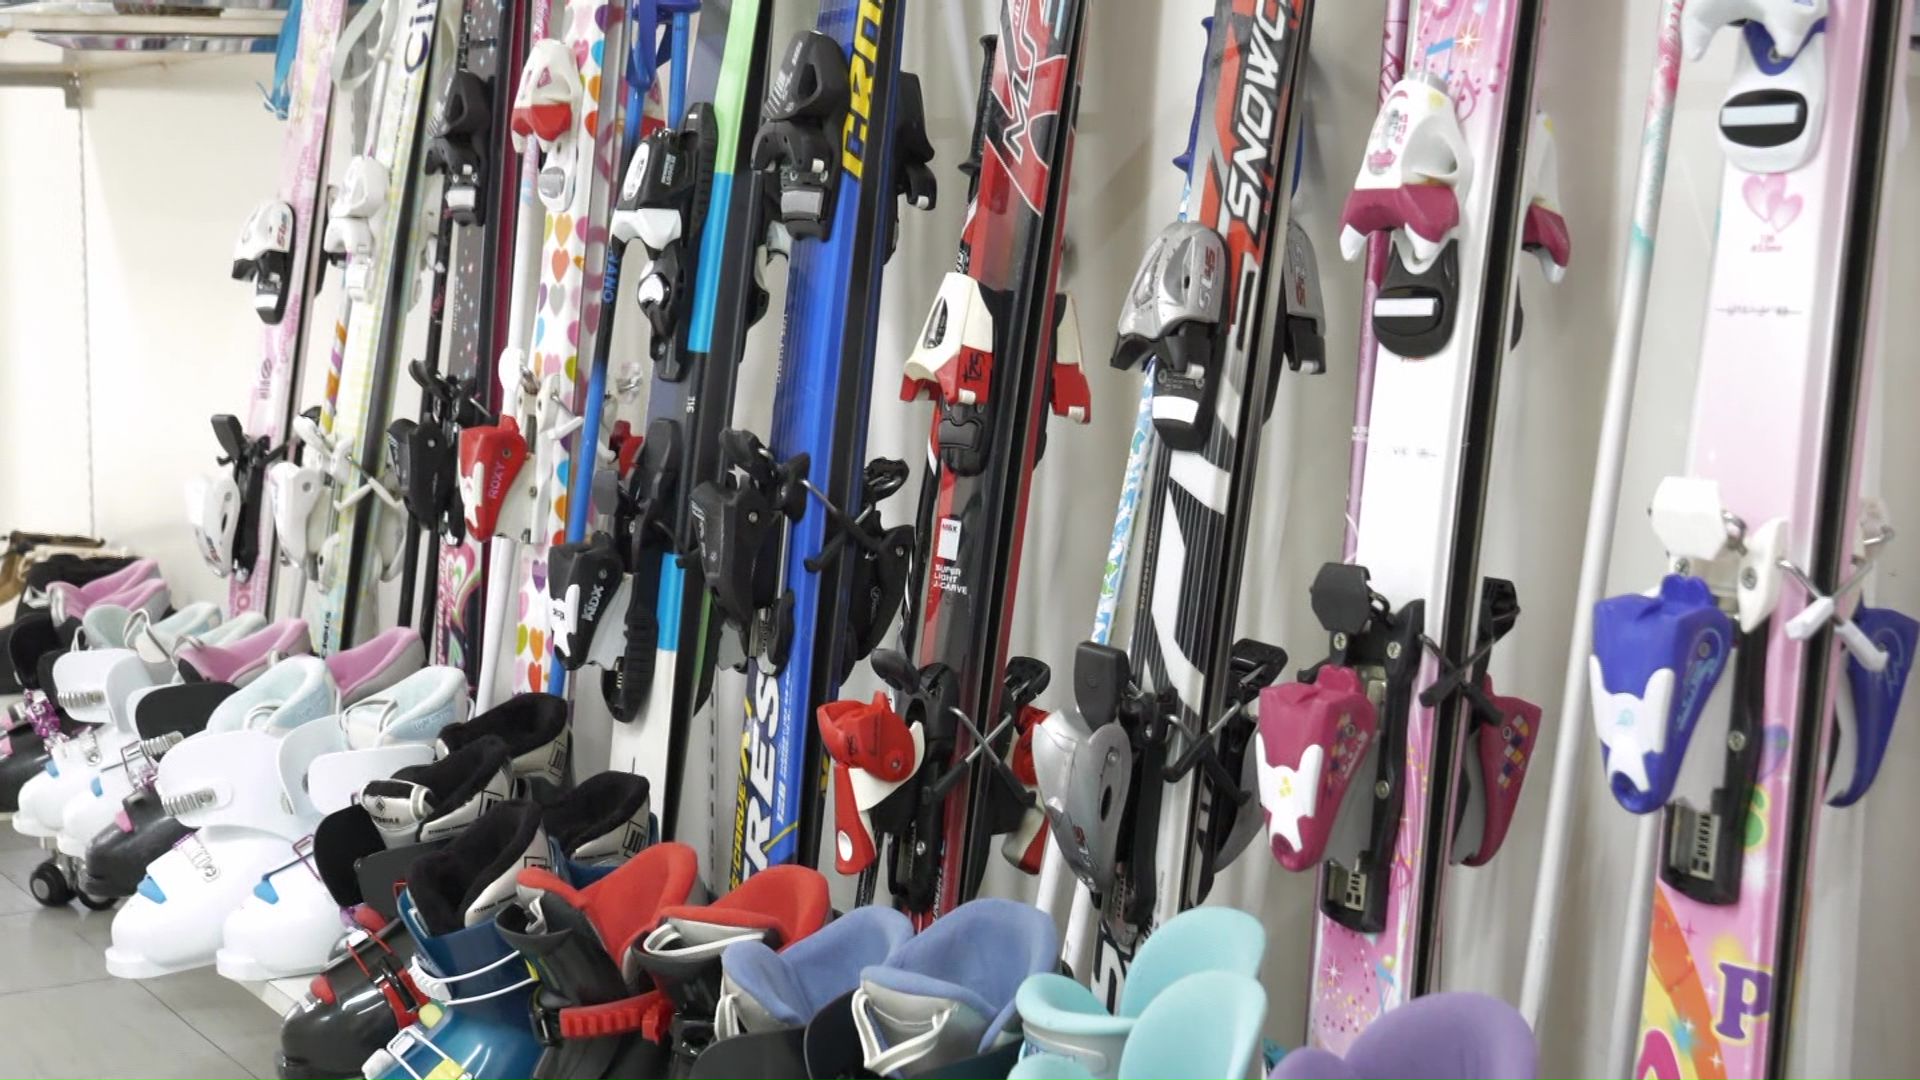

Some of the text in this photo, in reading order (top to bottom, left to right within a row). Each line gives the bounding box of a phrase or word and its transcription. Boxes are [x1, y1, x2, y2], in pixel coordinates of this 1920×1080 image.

[1227, 0, 1288, 235] SNOWC
[488, 460, 505, 499] ROXY
[934, 572, 958, 583] LIGHT
[935, 563, 962, 577] SUPER
[933, 580, 967, 595] J-CARVE
